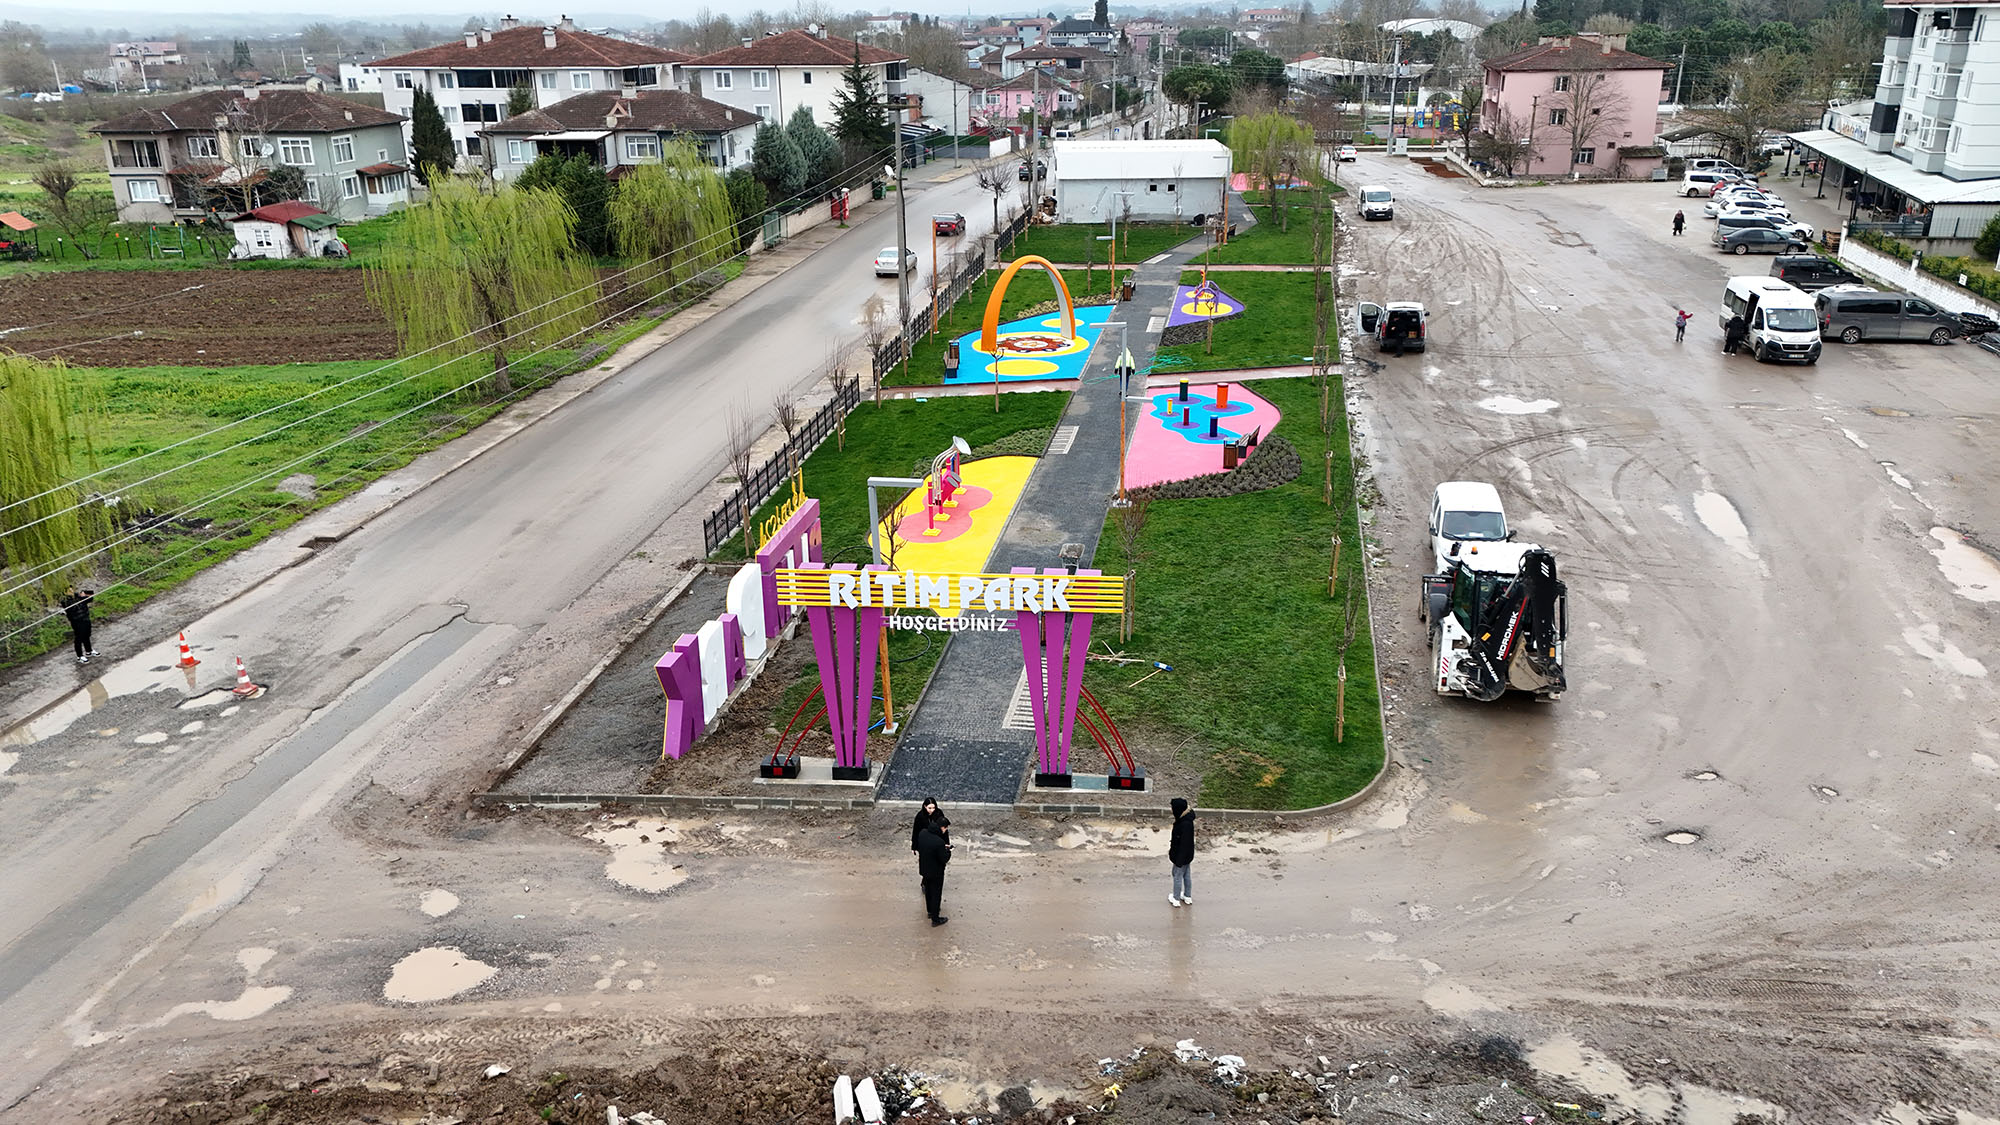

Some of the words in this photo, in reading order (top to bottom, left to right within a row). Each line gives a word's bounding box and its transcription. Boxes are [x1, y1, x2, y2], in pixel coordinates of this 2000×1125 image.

[828, 568, 950, 609] RİTİM
[958, 576, 1070, 614] PARK
[889, 613, 1009, 634] HOŞGELDİNİZ
